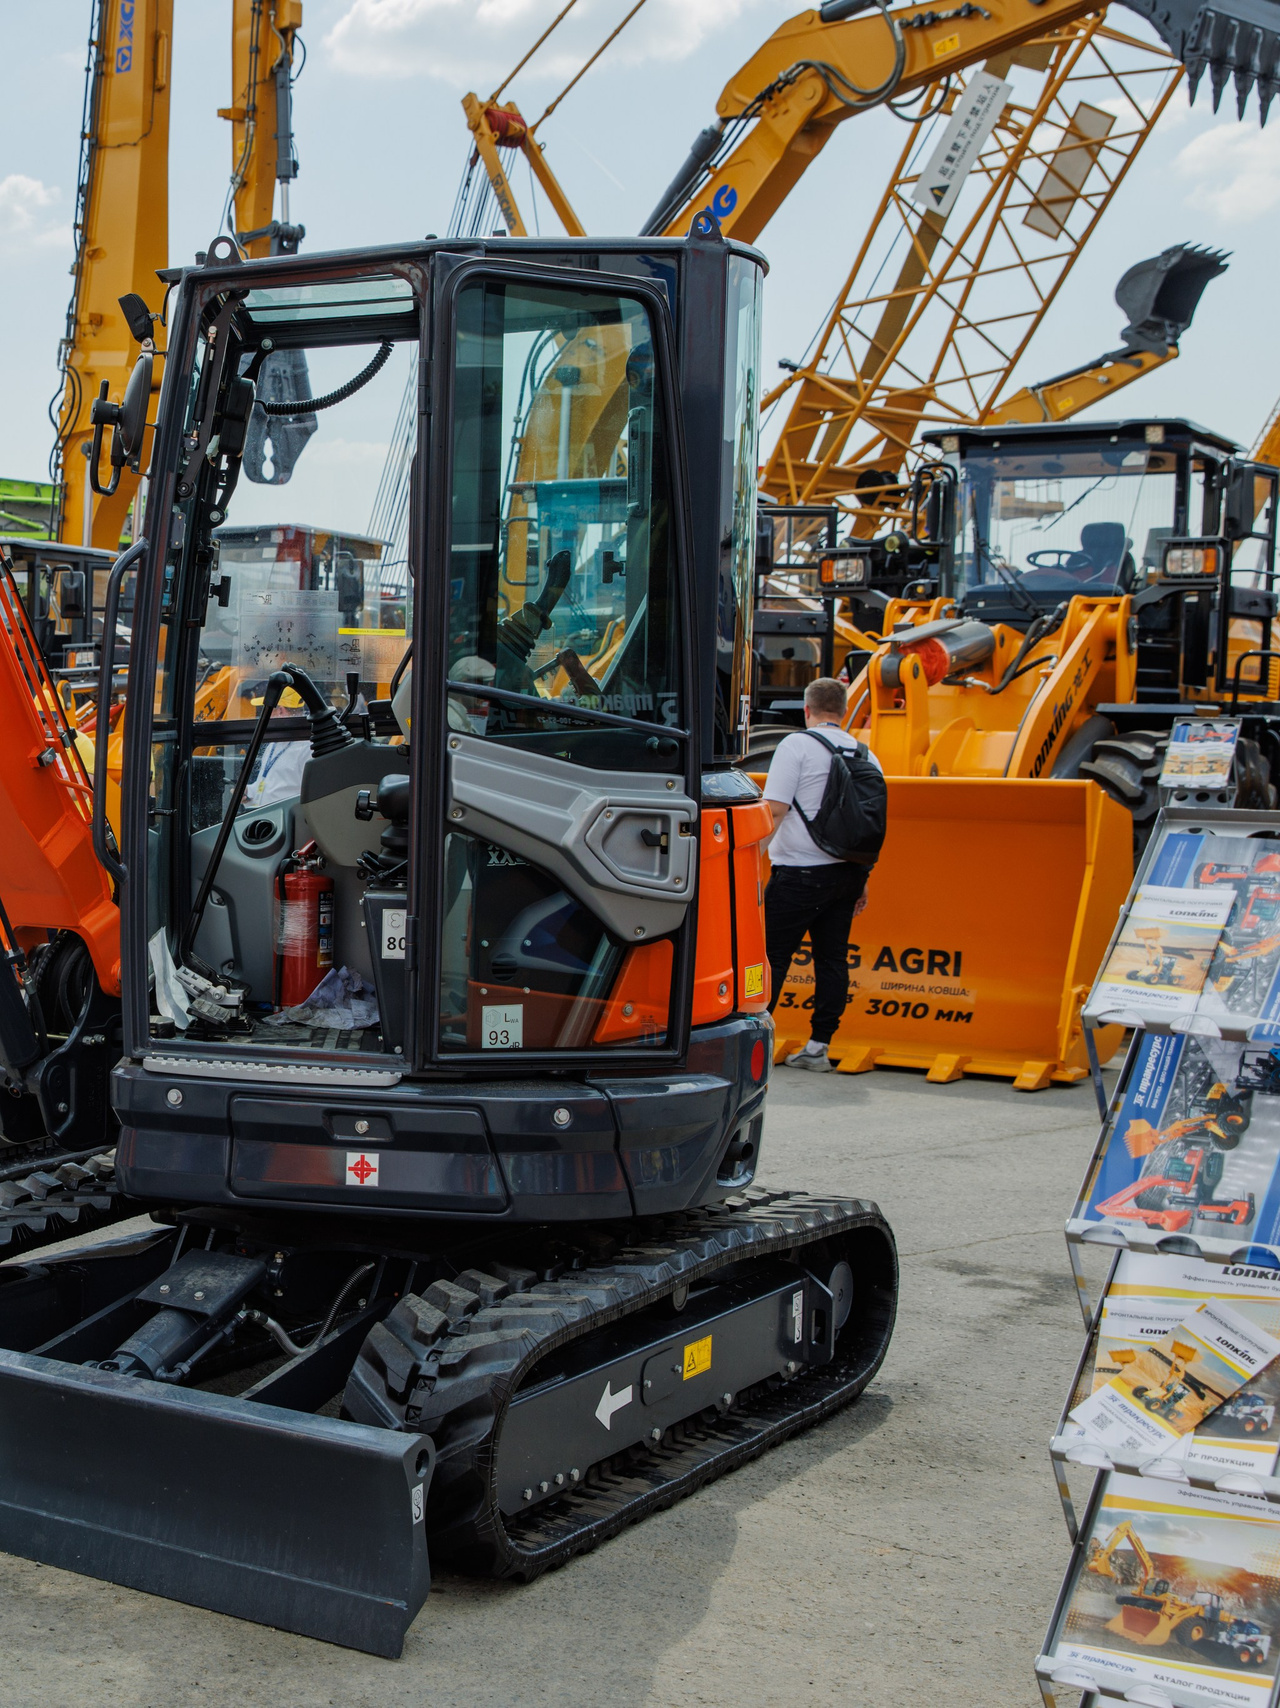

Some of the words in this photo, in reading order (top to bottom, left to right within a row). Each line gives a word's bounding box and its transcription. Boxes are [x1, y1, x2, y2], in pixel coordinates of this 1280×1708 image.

[119, 0, 135, 42] XC
[386, 936, 406, 950] 80
[872, 945, 962, 977] AGRI
[880, 981, 926, 993] ШИРИНА
[927, 985, 970, 997] КОВША:
[865, 998, 929, 1019] 3010
[488, 1030, 510, 1046] 93
[1138, 1035, 1163, 1094] тракресурс
[1182, 1273, 1234, 1286] Эффективность
[1235, 1282, 1270, 1290] управляет
[1109, 1311, 1154, 1321] ФРОНТАЛЬНЫЕ
[1204, 1309, 1240, 1336] ФРОНТАЛЬНЫЕ
[1118, 1403, 1166, 1440] тракресурс
[1200, 1453, 1255, 1467] ПРОДУКЦИИ
[1177, 1489, 1230, 1505] Эффективность
[1231, 1501, 1266, 1512] управляет
[1081, 1654, 1137, 1673] тракресурс
[1153, 1673, 1194, 1689] КАТАЛОГ
[1195, 1685, 1251, 1702] ПРОДУКЦИИ
